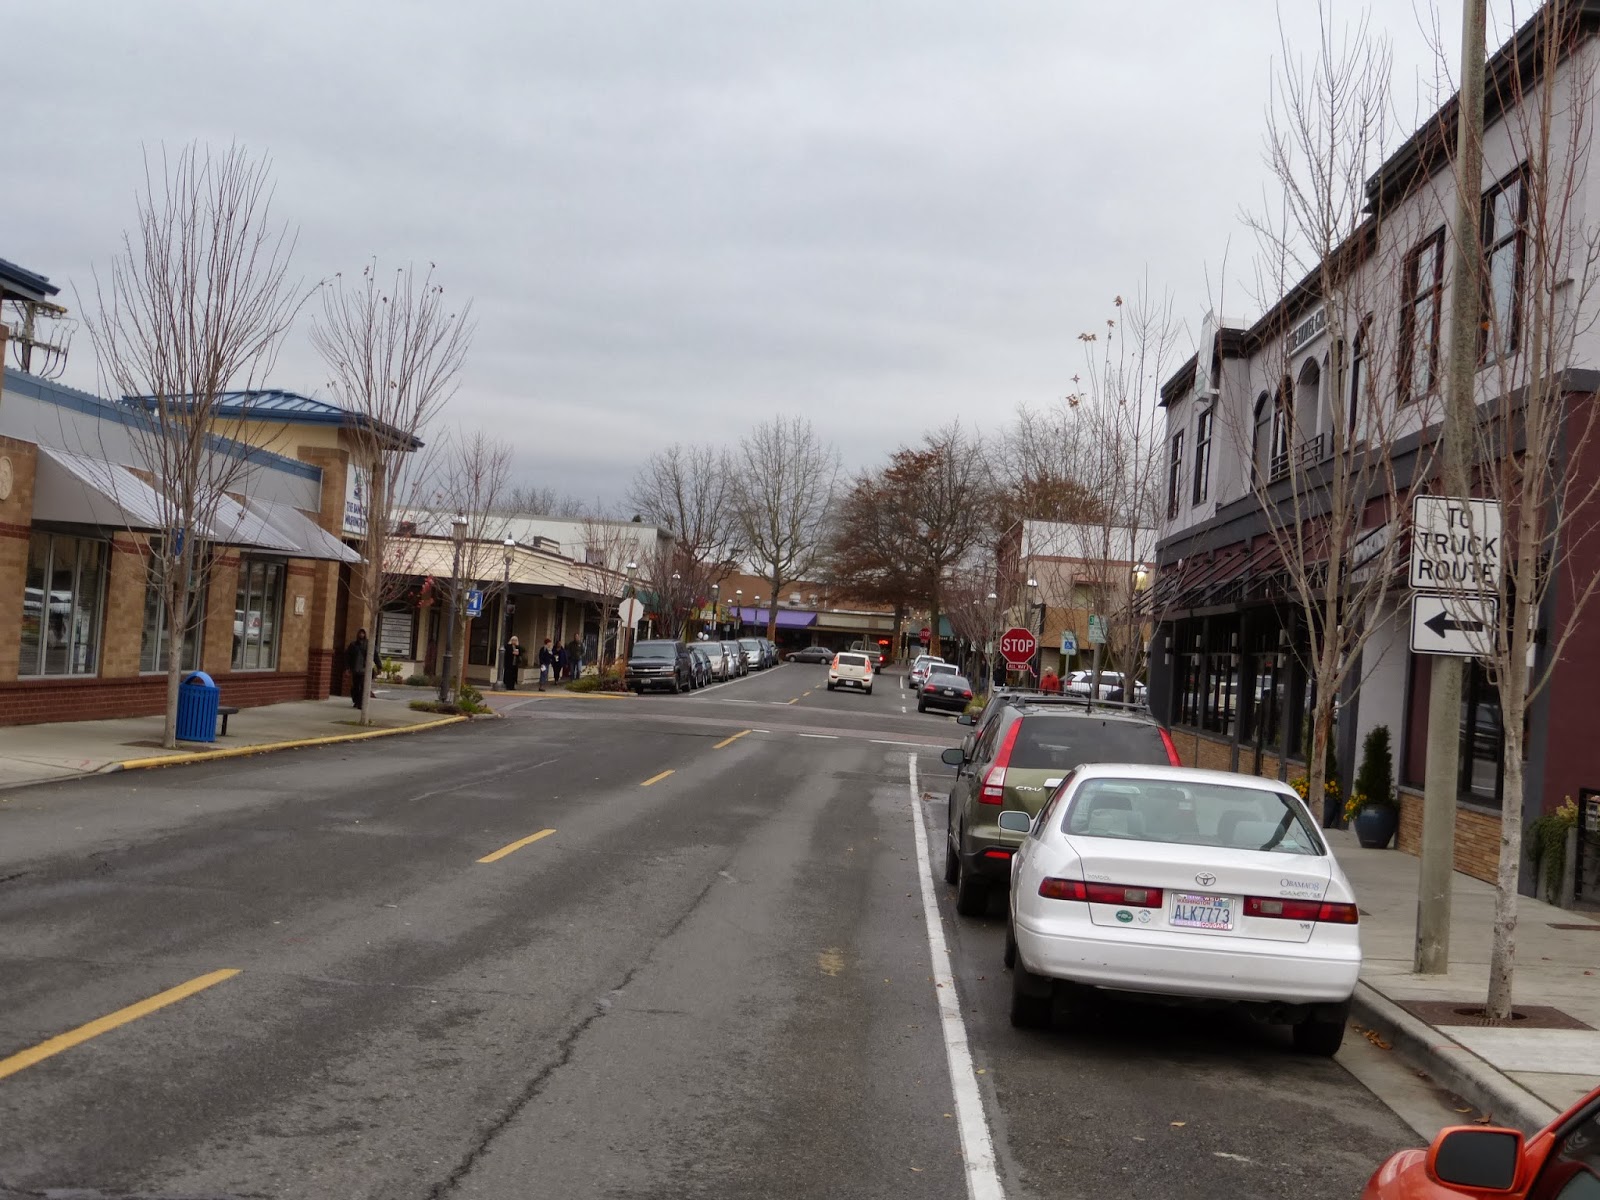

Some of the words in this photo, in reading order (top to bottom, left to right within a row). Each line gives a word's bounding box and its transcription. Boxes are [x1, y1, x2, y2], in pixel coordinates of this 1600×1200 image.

[1449, 507, 1473, 529] TO
[1420, 532, 1498, 558] TRUCK
[1418, 559, 1495, 584] ROUTE
[1003, 638, 1034, 652] STOP
[1175, 904, 1230, 924] ALK7773
